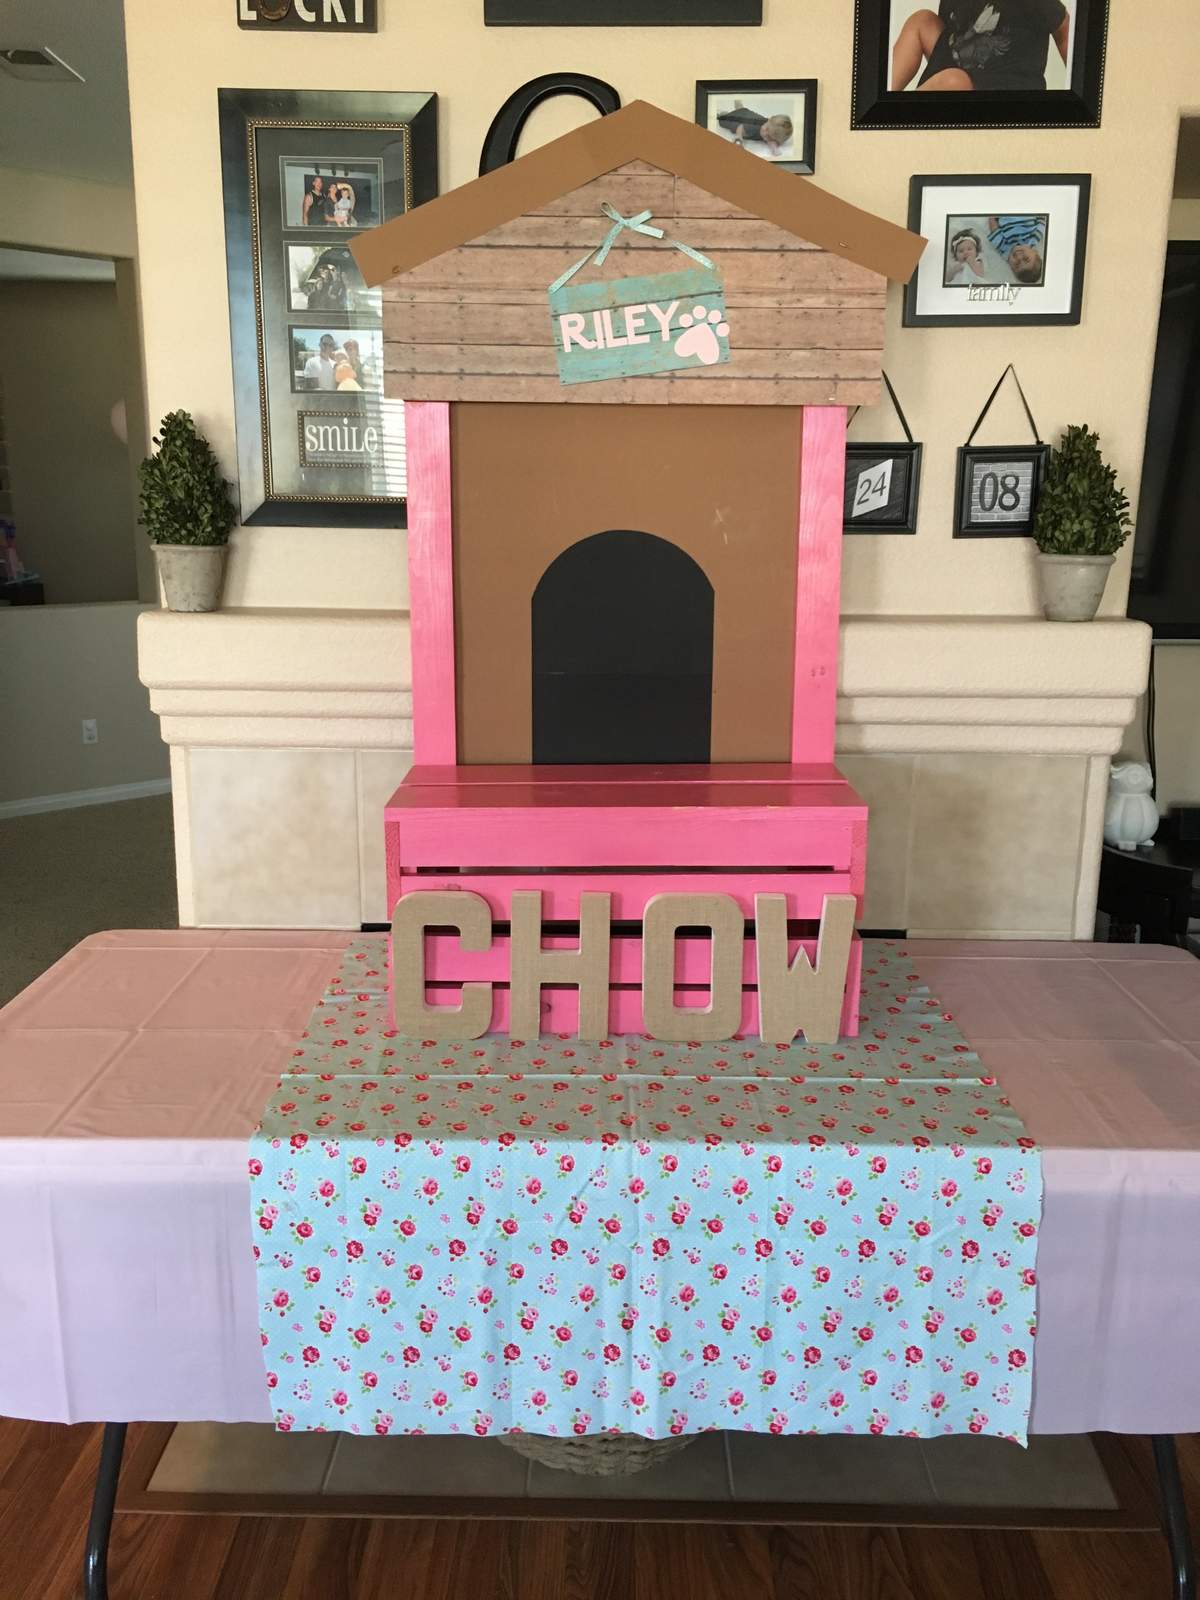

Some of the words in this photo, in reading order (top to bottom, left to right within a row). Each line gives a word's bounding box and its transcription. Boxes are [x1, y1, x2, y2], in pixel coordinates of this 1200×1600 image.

[559, 301, 680, 353] RILEY
[856, 471, 887, 506] 24
[978, 471, 1021, 512] 08
[391, 889, 857, 1044] CHOW
